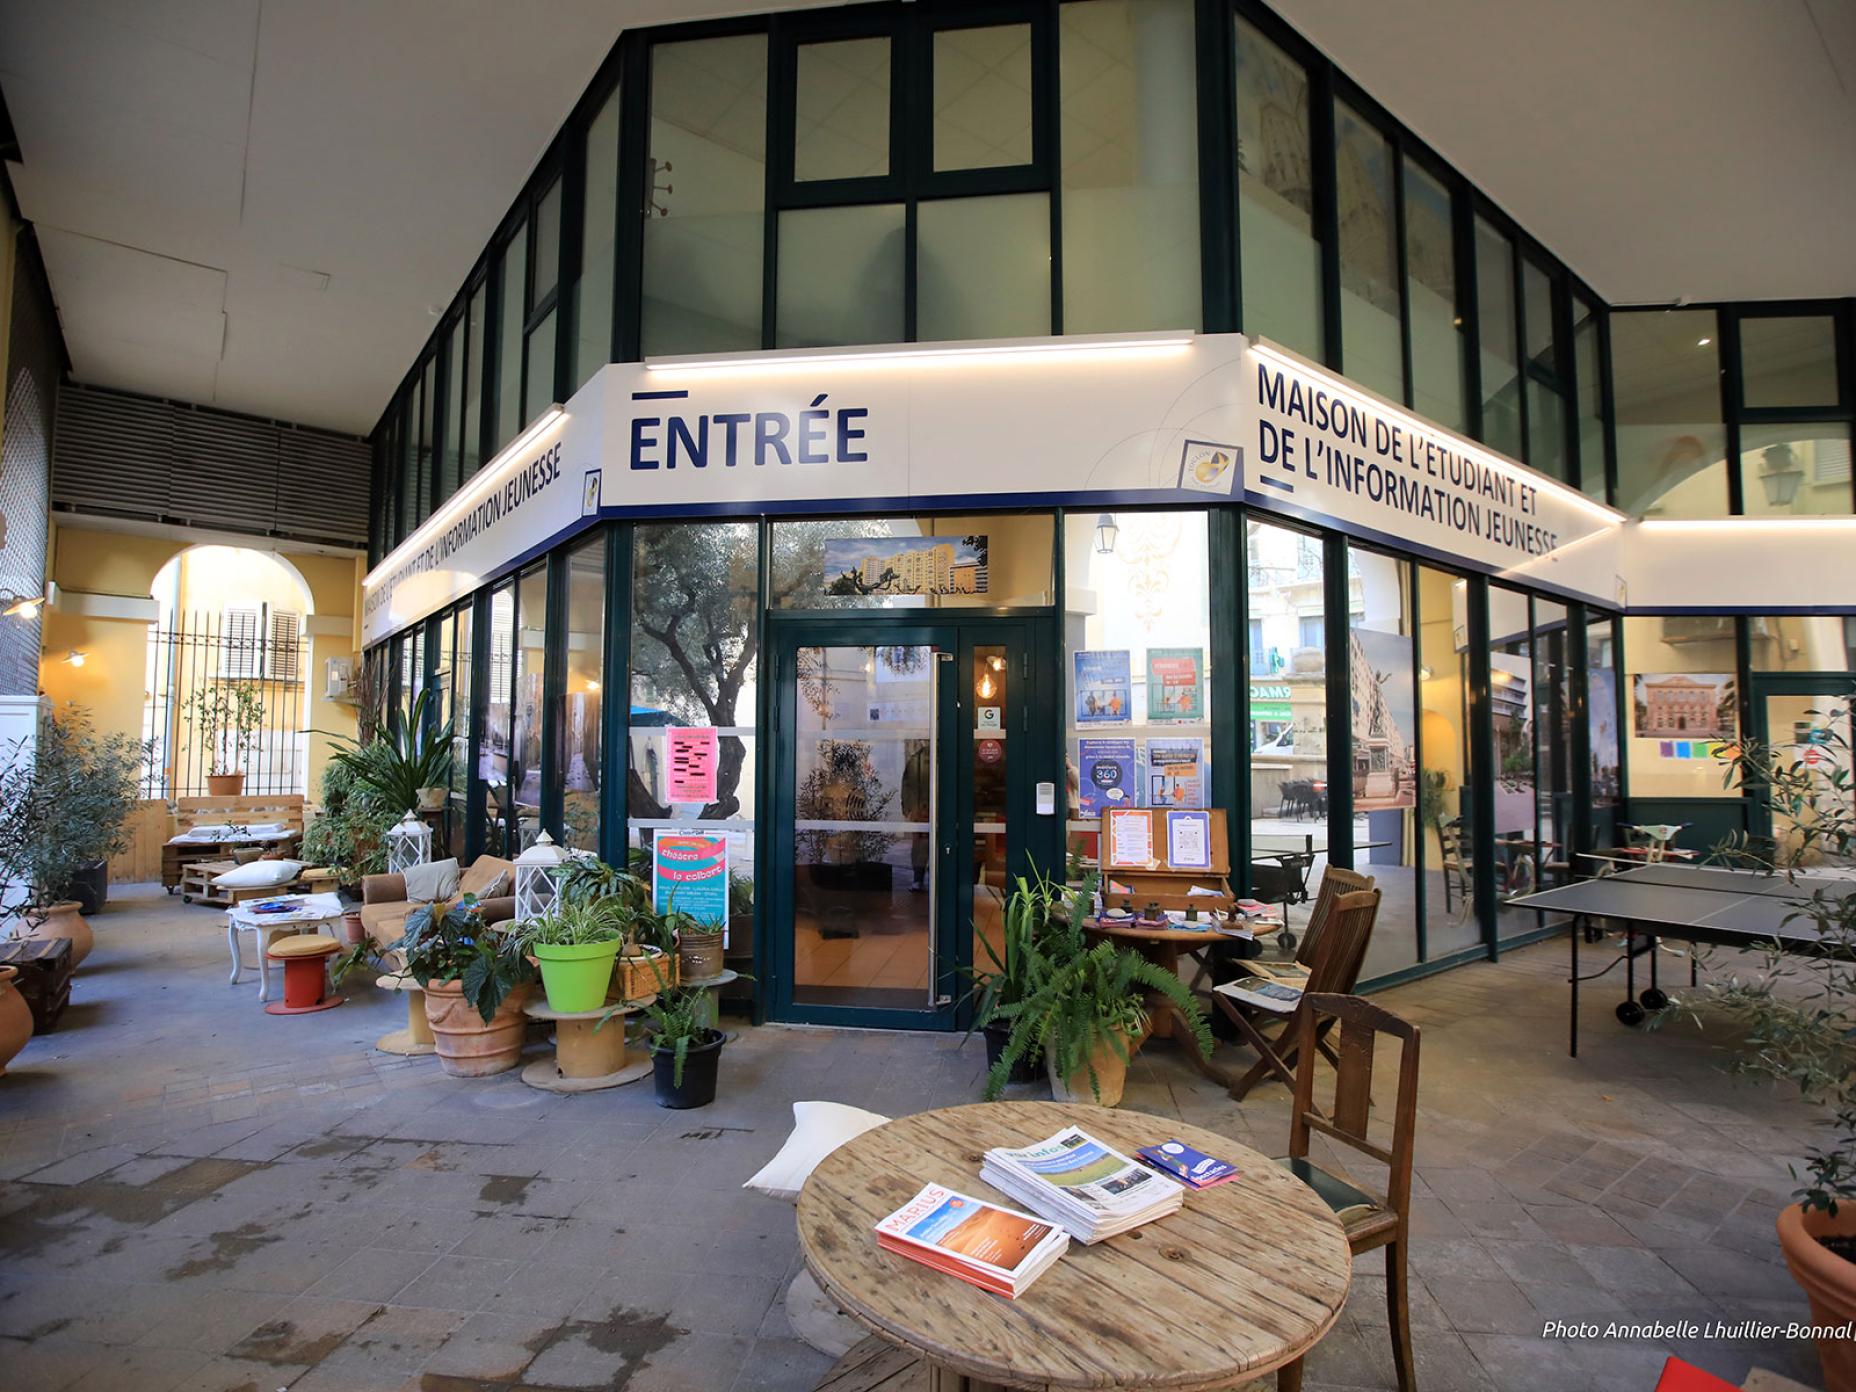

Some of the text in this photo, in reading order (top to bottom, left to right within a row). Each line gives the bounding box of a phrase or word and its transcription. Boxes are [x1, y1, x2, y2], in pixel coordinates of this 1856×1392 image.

[629, 393, 868, 471] ENTRÉE
[1258, 362, 1367, 448] MAISON
[1375, 419, 1402, 463] DE
[1521, 483, 1537, 516] ET
[502, 441, 562, 517] JEUNESSE
[1259, 419, 1557, 556] DE L'INFORMATION JEUNESSE
[884, 1189, 945, 1232] MARIUS
